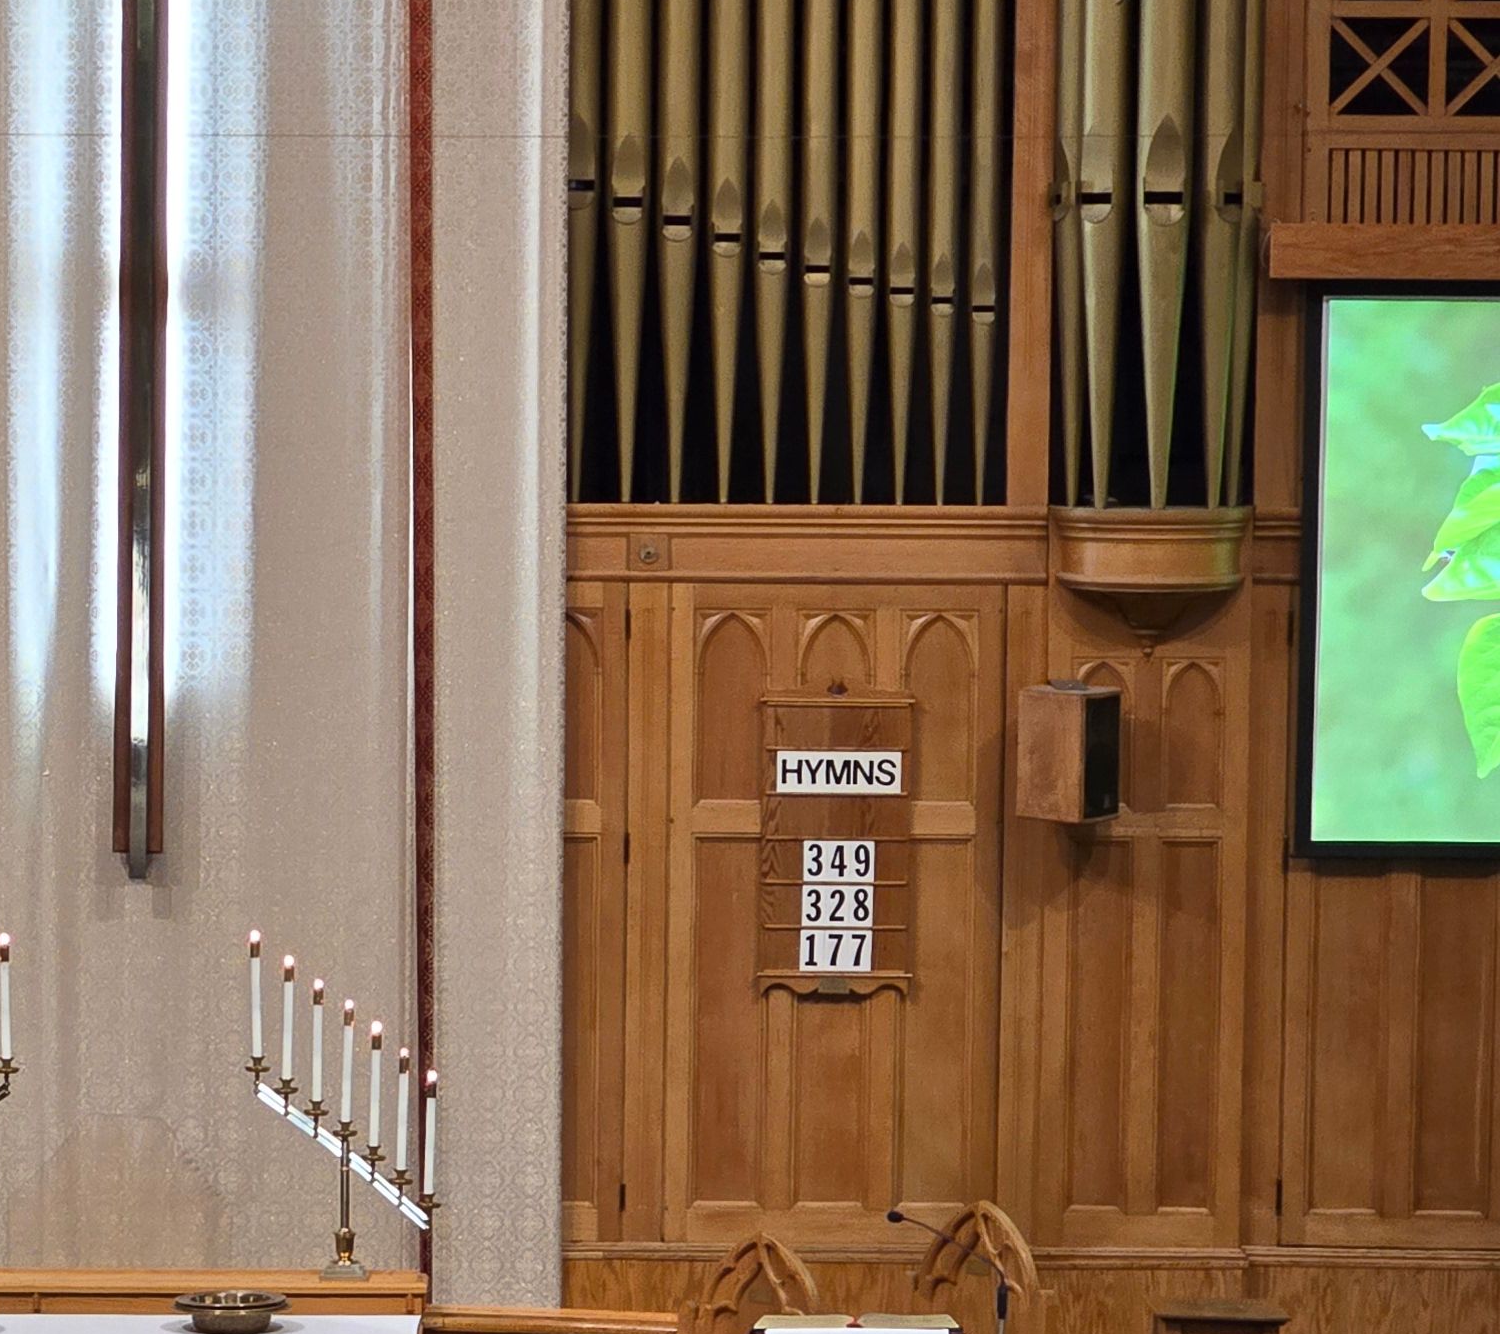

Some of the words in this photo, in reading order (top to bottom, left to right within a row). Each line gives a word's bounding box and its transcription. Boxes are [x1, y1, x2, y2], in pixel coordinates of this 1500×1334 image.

[782, 759, 896, 785] HYMNS
[808, 844, 870, 877] 349
[806, 889, 869, 921] 328
[805, 934, 866, 966] 177
